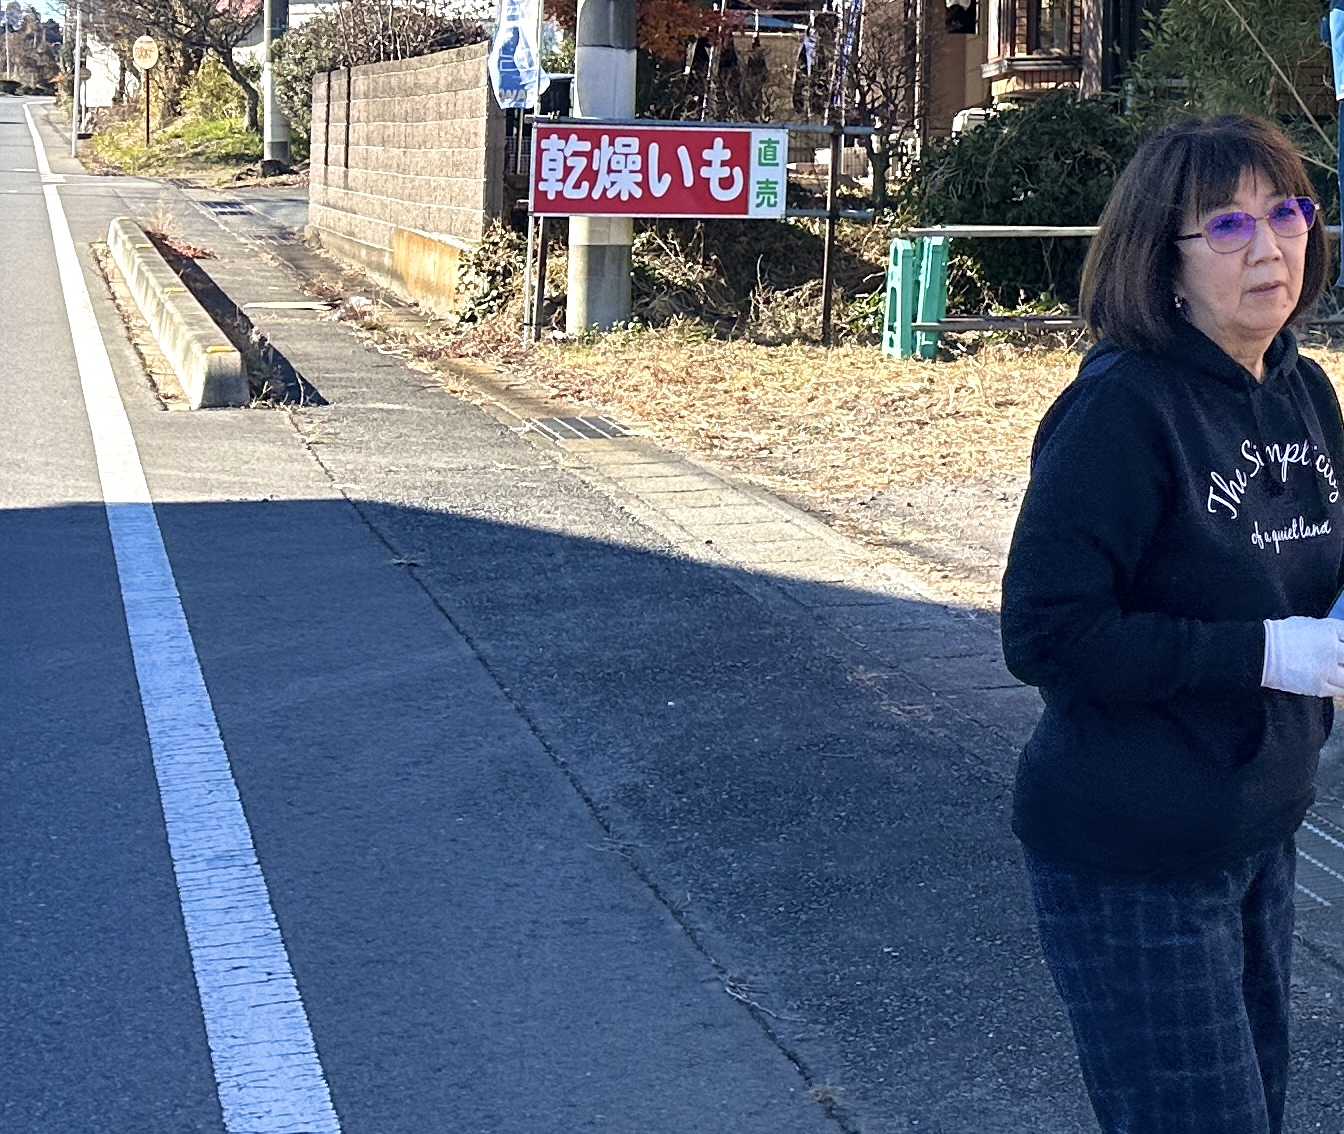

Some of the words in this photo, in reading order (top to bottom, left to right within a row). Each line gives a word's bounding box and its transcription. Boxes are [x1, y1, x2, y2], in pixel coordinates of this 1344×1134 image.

[538, 133, 745, 203] 乾燥いも
[755, 137, 780, 209] 直売
[1206, 468, 1249, 520] The
[1251, 521, 1265, 550] of
[1271, 518, 1300, 555] quiet
[1299, 515, 1332, 539] land
